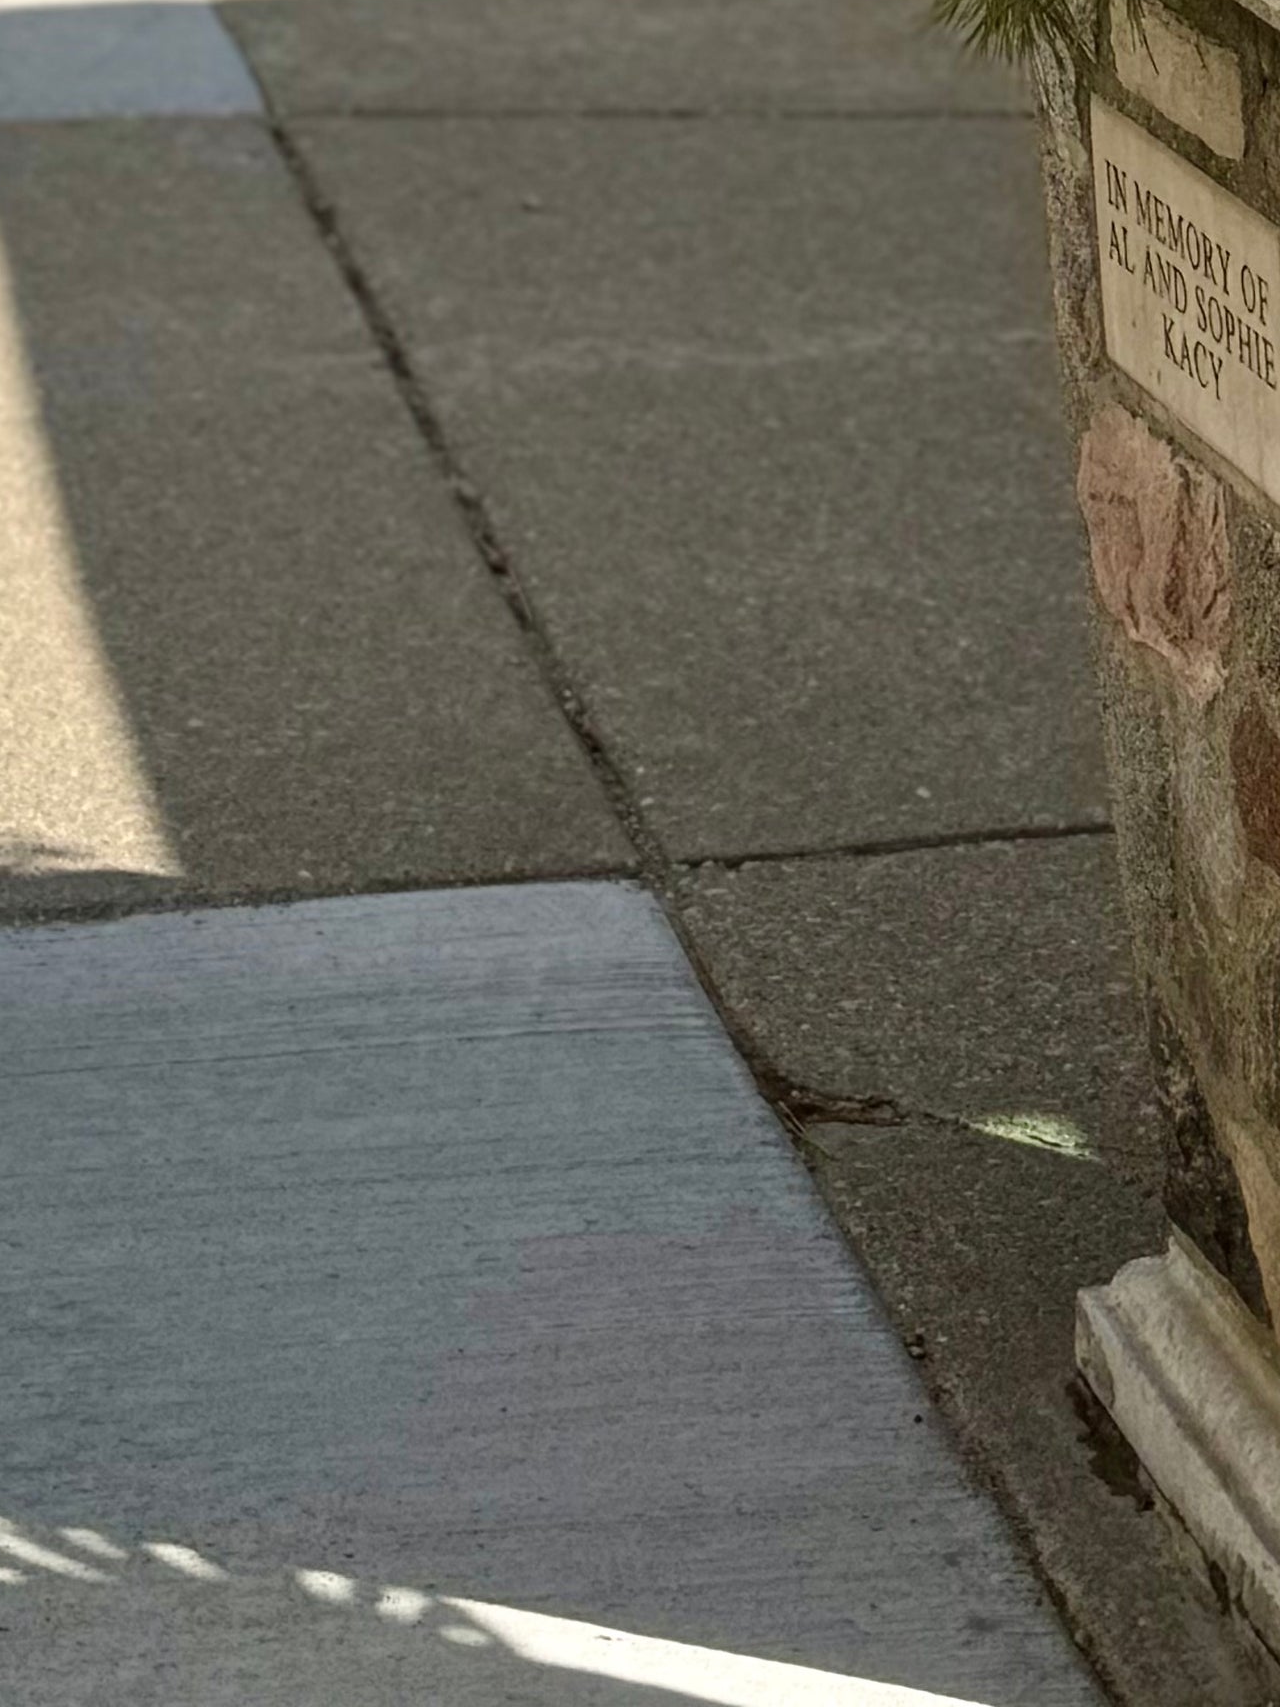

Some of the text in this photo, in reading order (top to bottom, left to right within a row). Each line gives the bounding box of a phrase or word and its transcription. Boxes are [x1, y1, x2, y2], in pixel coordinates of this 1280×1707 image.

[1105, 160, 1269, 327] IN MEMORY OF
[1109, 221, 1277, 390] AL AND SOPHIE
[1163, 314, 1223, 400] KACY
